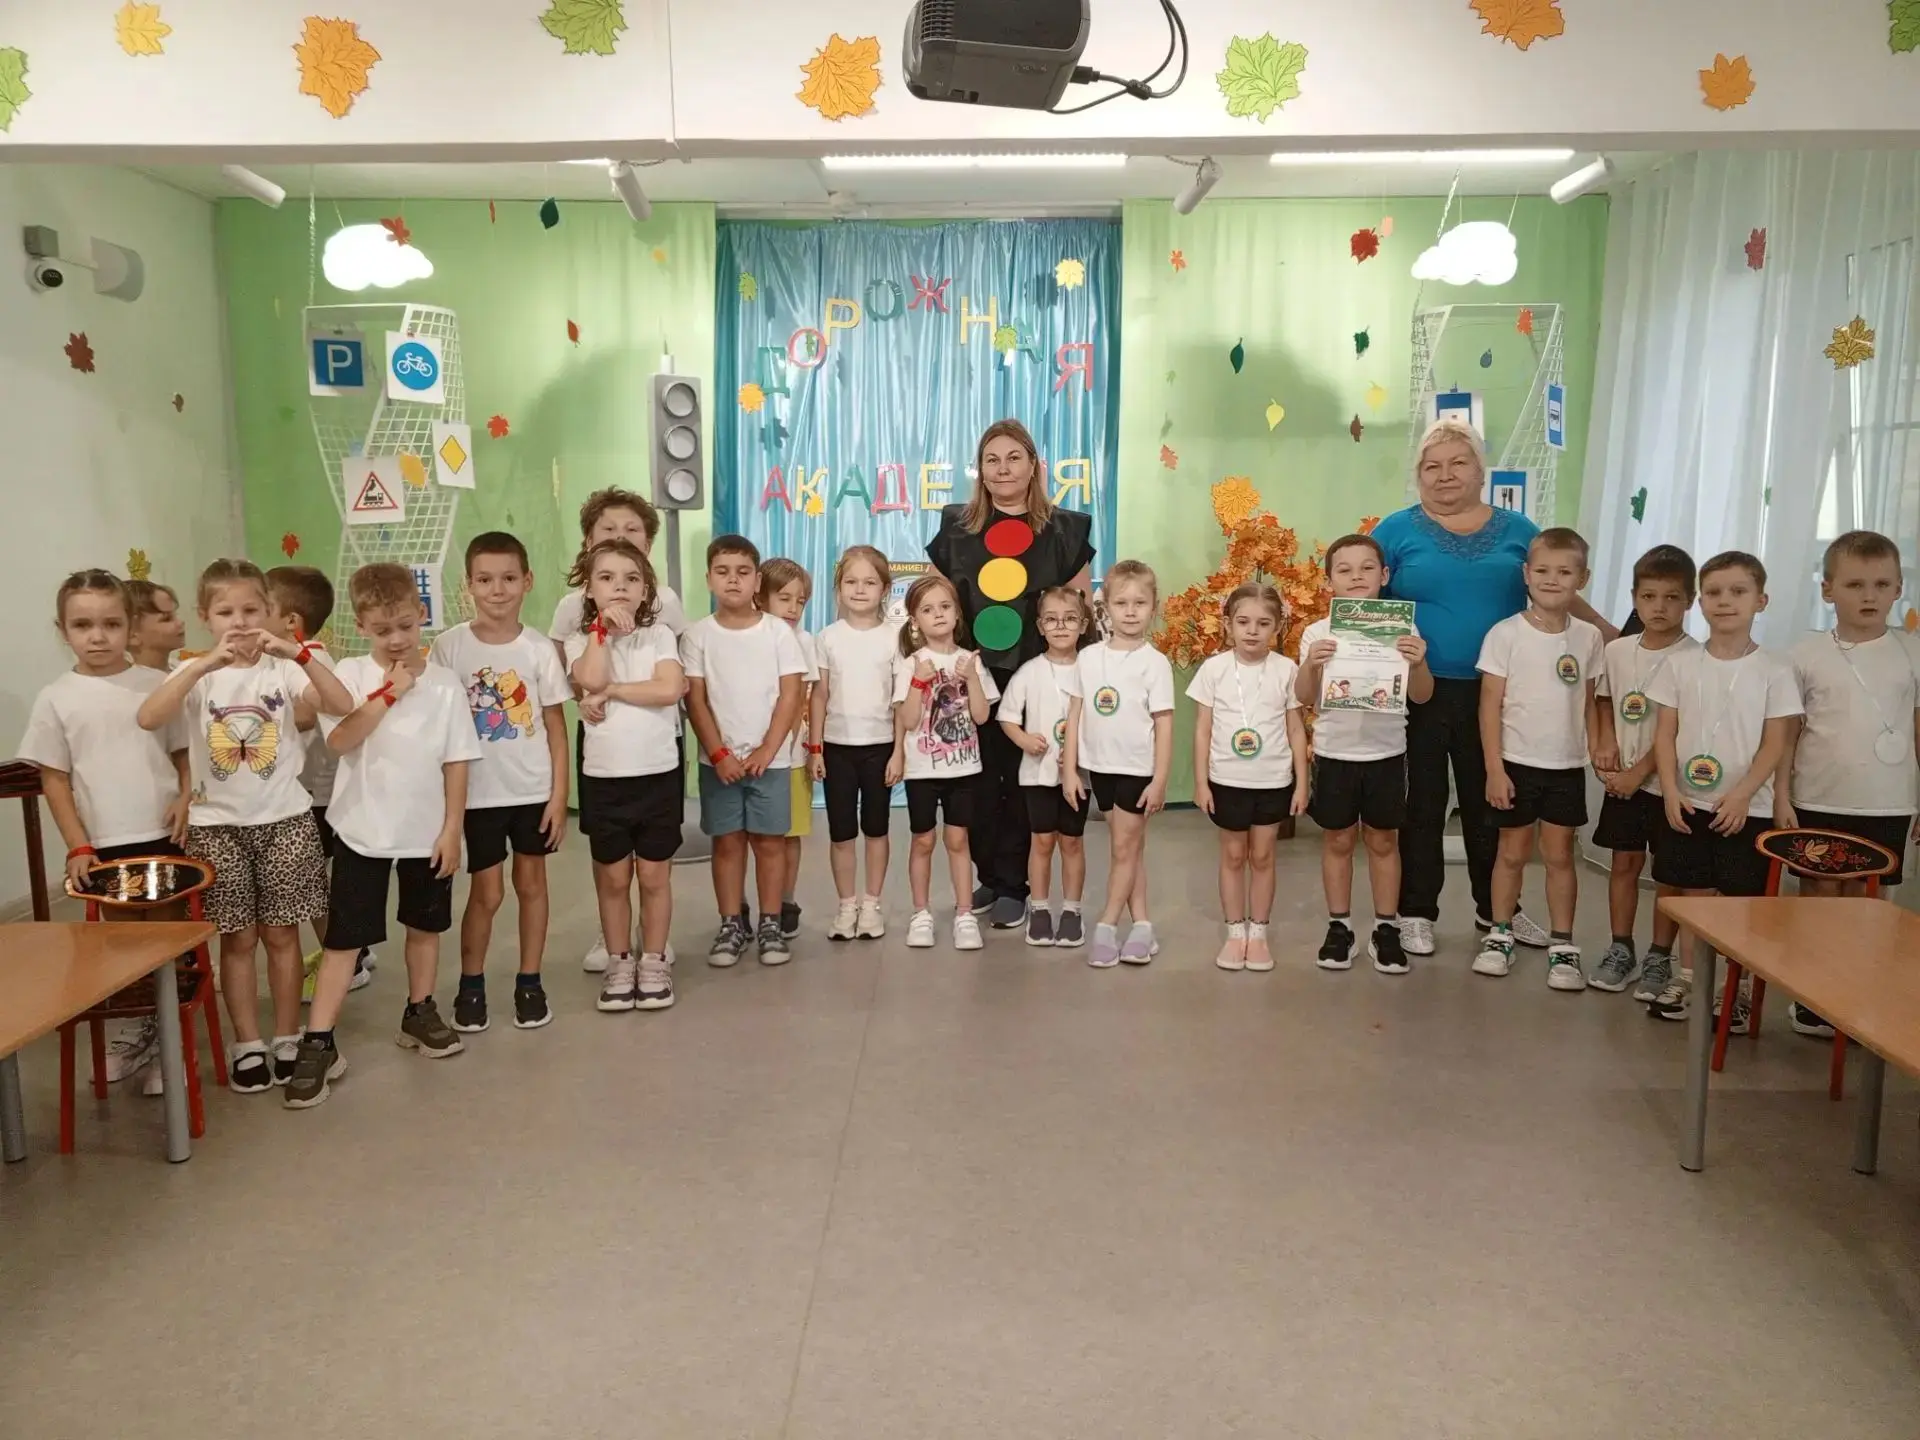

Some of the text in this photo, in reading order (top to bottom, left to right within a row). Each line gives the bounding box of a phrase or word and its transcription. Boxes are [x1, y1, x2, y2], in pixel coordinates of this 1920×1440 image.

[327, 344, 353, 382] P
[759, 458, 1092, 515] АКАДЕЯ
[931, 740, 979, 770] FUNN
